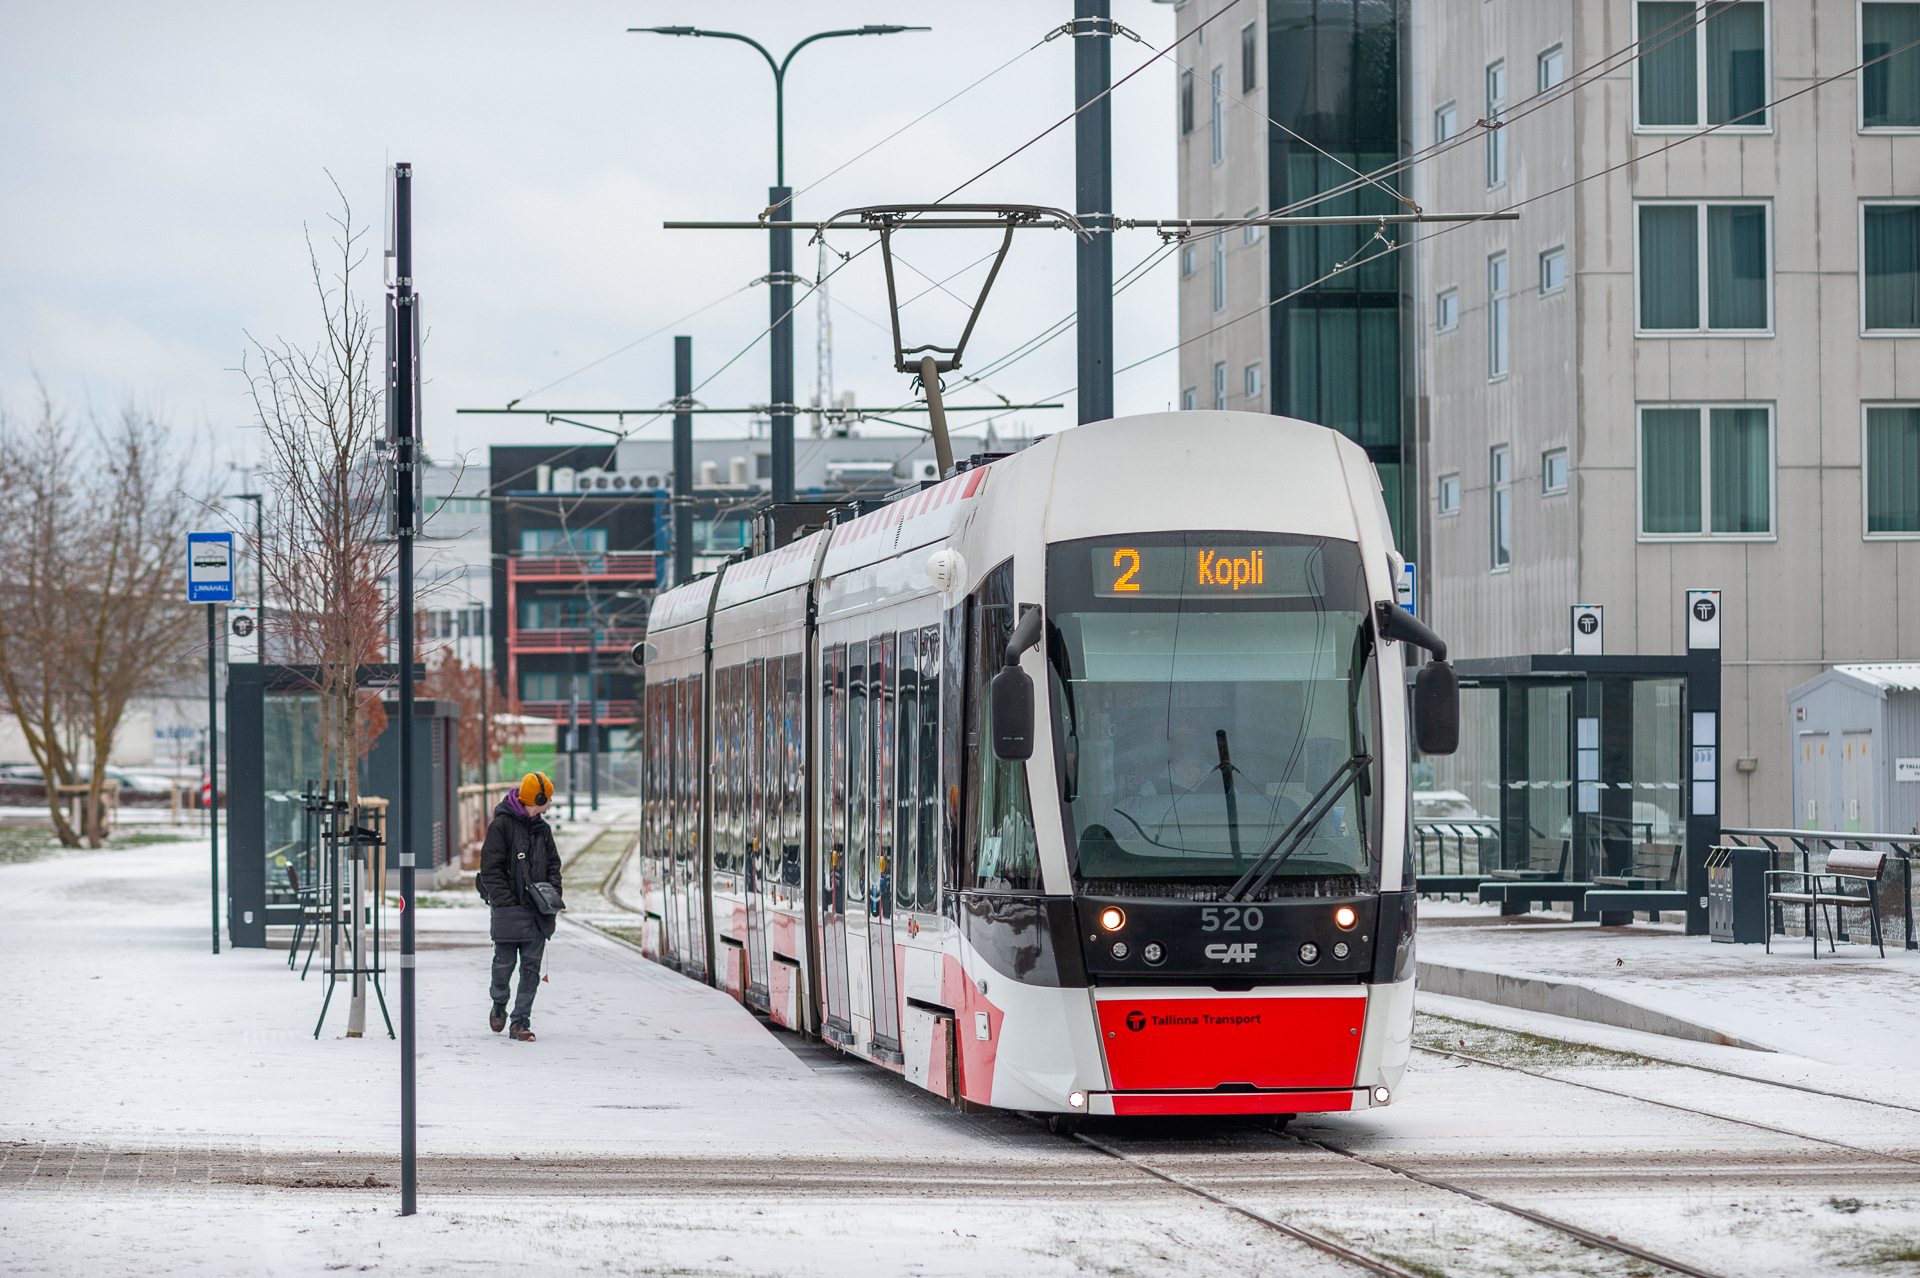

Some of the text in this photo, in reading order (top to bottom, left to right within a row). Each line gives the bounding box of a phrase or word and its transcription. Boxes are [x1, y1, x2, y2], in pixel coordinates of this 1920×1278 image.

[1113, 549, 1263, 591] 2 Kopli
[1201, 907, 1264, 932] 520
[1204, 943, 1258, 963] CAF
[1151, 1014, 1262, 1026] Tallinna Transport
